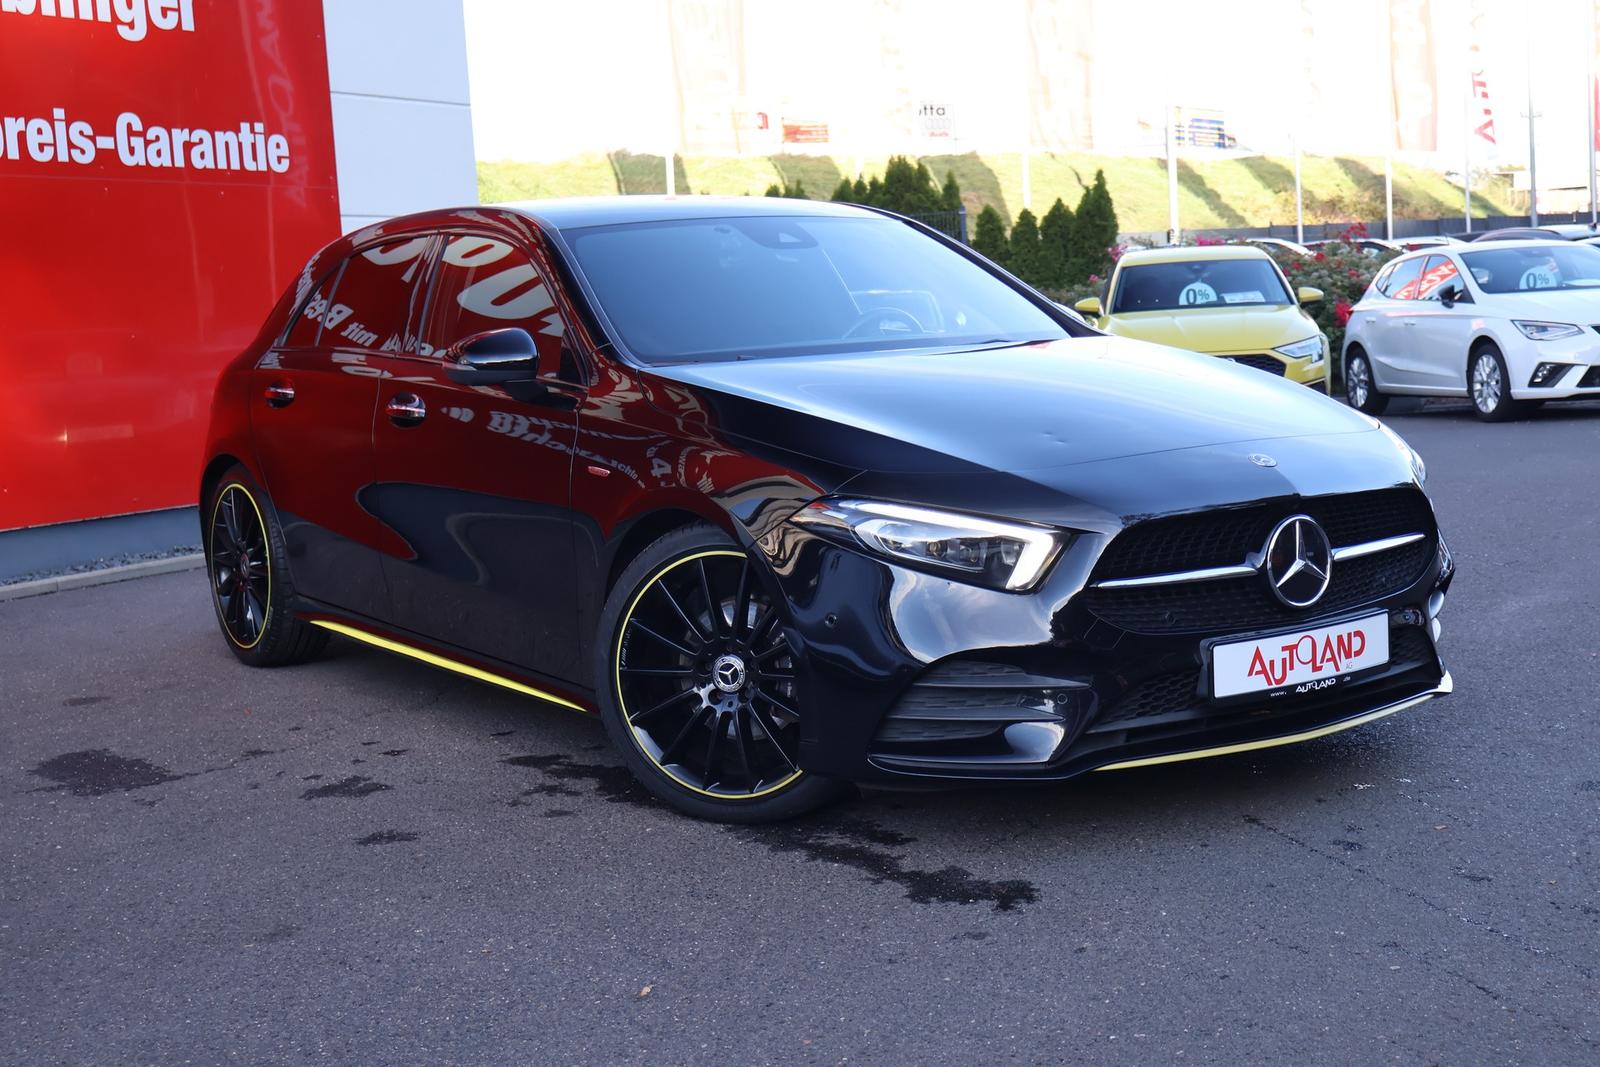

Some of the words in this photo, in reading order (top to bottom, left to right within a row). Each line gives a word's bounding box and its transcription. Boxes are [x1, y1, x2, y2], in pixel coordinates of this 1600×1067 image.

[919, 104, 946, 117] tta
[0, 108, 290, 173] reis-Garantie
[1526, 272, 1550, 290] 0%
[1186, 288, 1210, 305] 0%
